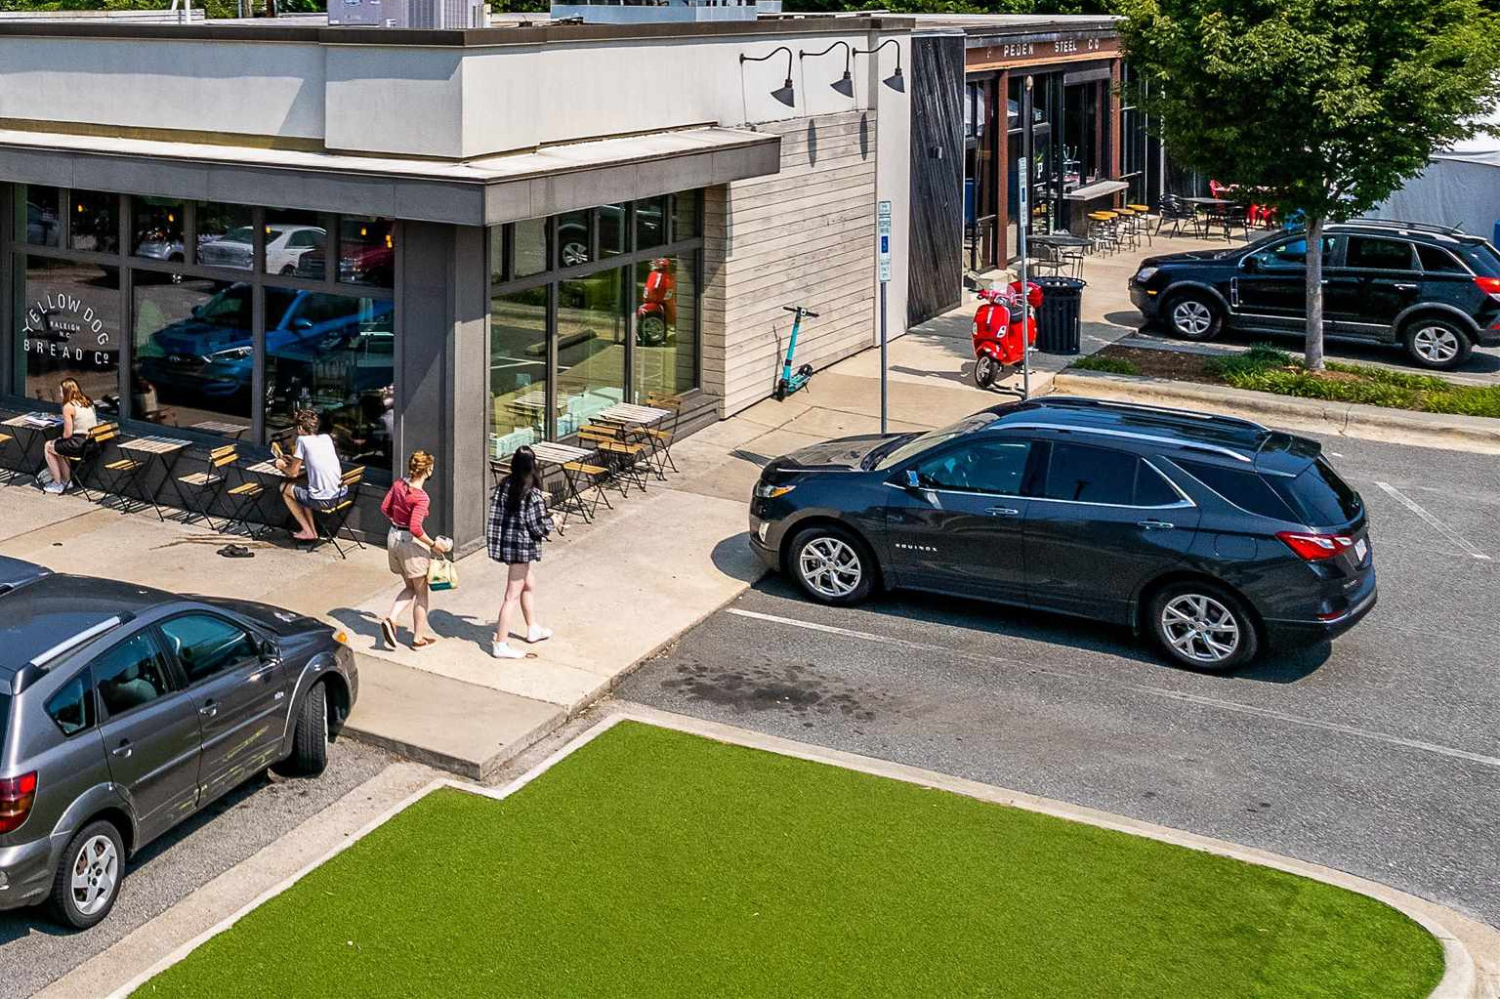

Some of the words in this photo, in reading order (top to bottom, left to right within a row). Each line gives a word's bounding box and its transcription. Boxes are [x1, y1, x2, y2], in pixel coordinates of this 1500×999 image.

[1003, 43, 1034, 57] PEDEN
[1055, 40, 1077, 53] STEEL
[1088, 39, 1100, 50] CO
[22, 293, 81, 332] YELLOW
[83, 307, 109, 345] DOG
[50, 321, 80, 332] RALEIGH
[23, 339, 82, 361] BREAD
